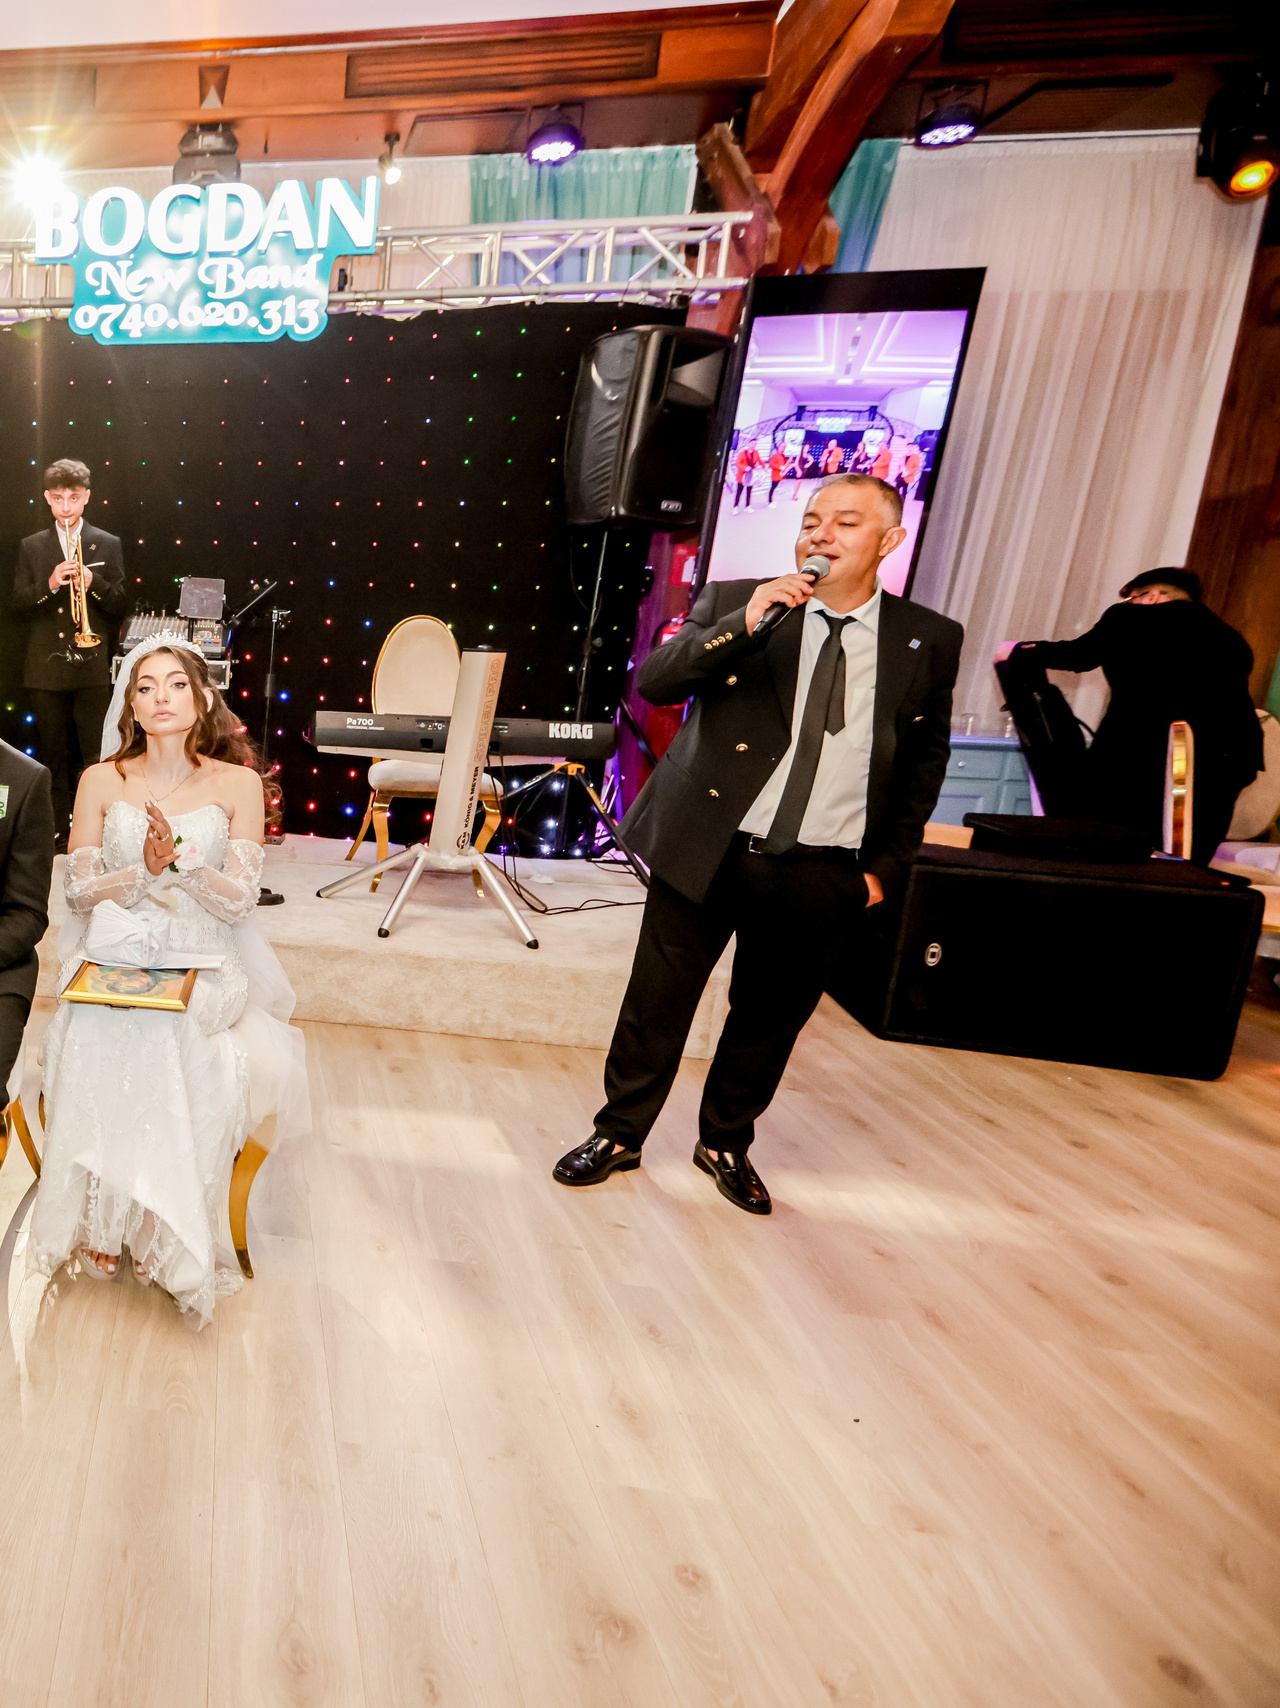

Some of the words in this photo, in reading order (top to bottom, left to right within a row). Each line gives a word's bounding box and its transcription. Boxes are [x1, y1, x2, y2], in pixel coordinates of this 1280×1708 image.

[35, 175, 378, 259] BOGDAN
[85, 260, 188, 301] New
[197, 254, 324, 299] Band
[74, 291, 320, 339] 0740.620.313
[486, 659, 501, 697] PRO
[346, 717, 374, 726] Pa700
[474, 699, 494, 762] SPIDER
[548, 722, 593, 740] KORG
[470, 766, 479, 795] MEYER
